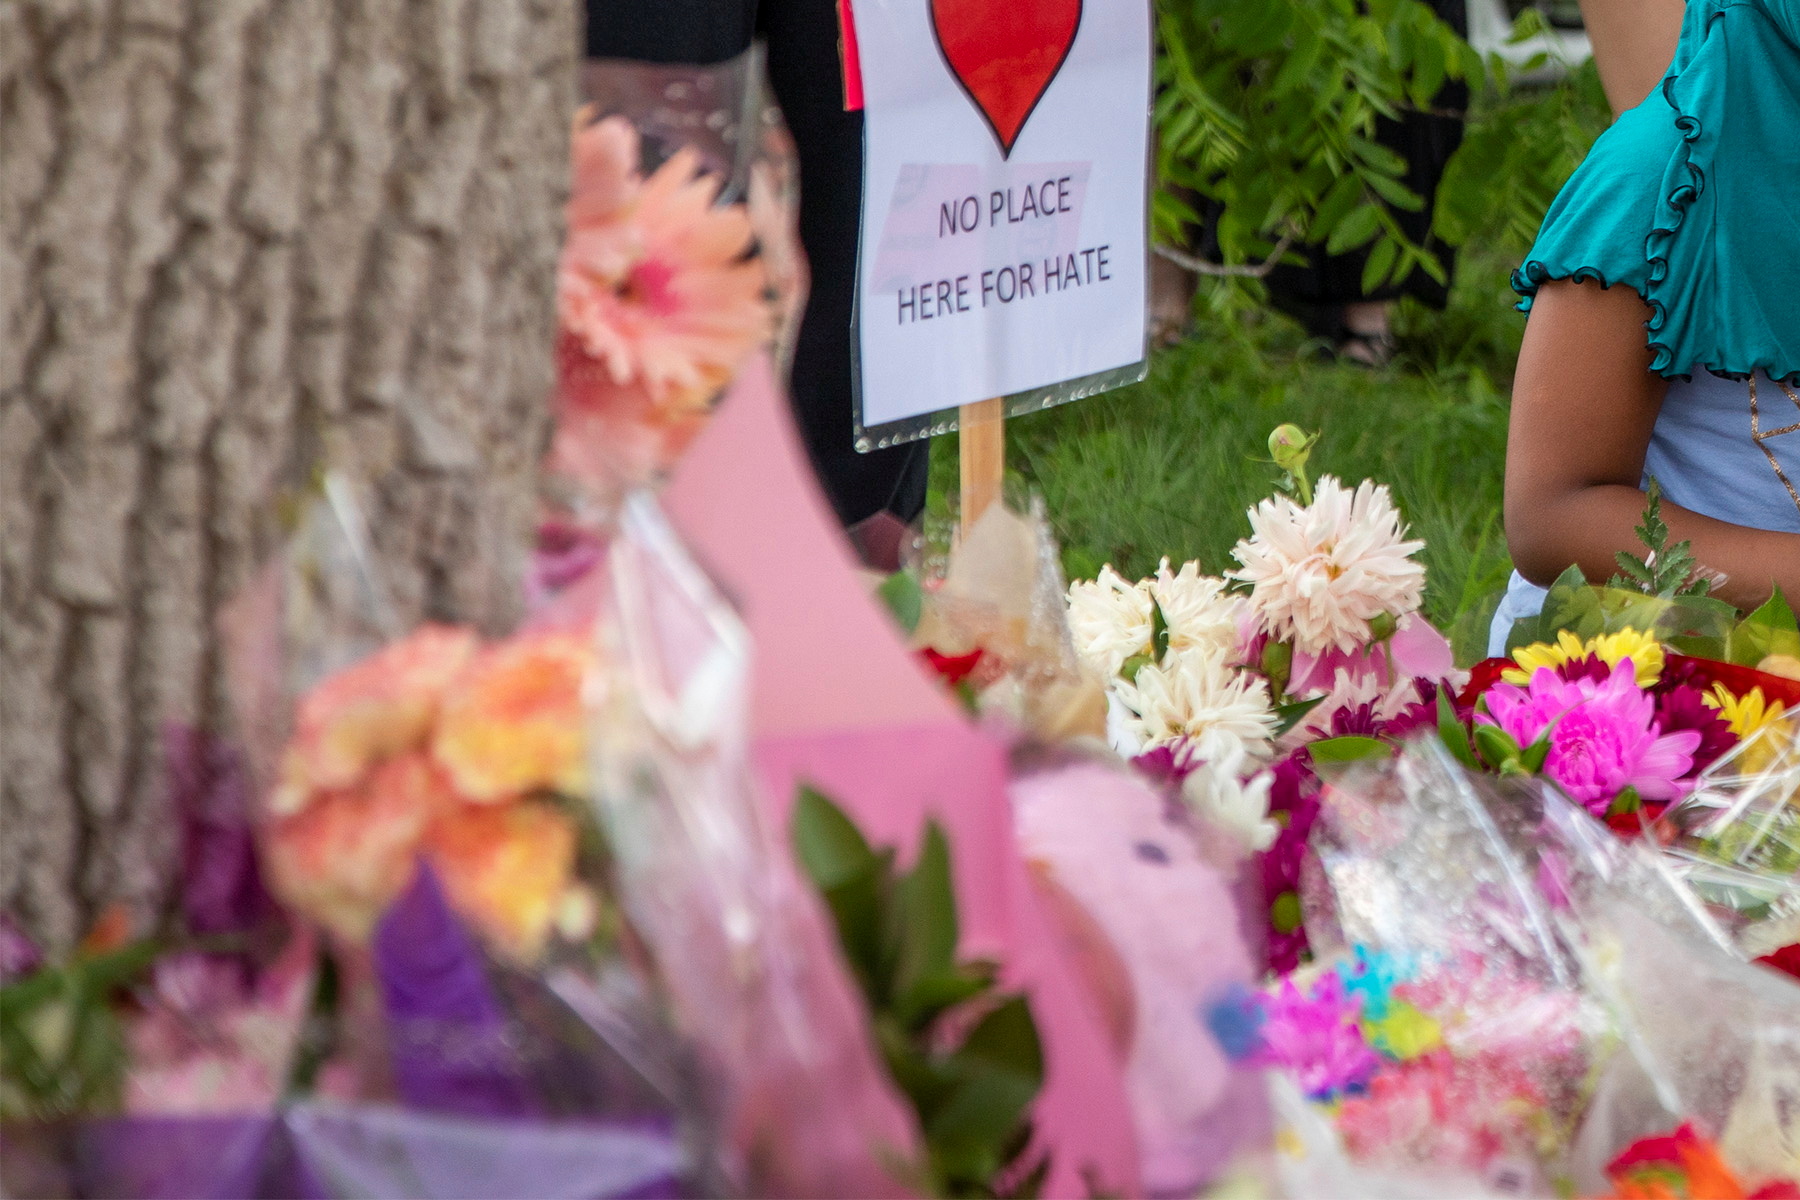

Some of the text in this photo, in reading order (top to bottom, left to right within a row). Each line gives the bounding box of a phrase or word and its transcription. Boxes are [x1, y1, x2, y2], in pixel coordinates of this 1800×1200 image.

[939, 177, 1071, 238] NO PLACE
[898, 245, 1111, 325] HERE FOR HATE
